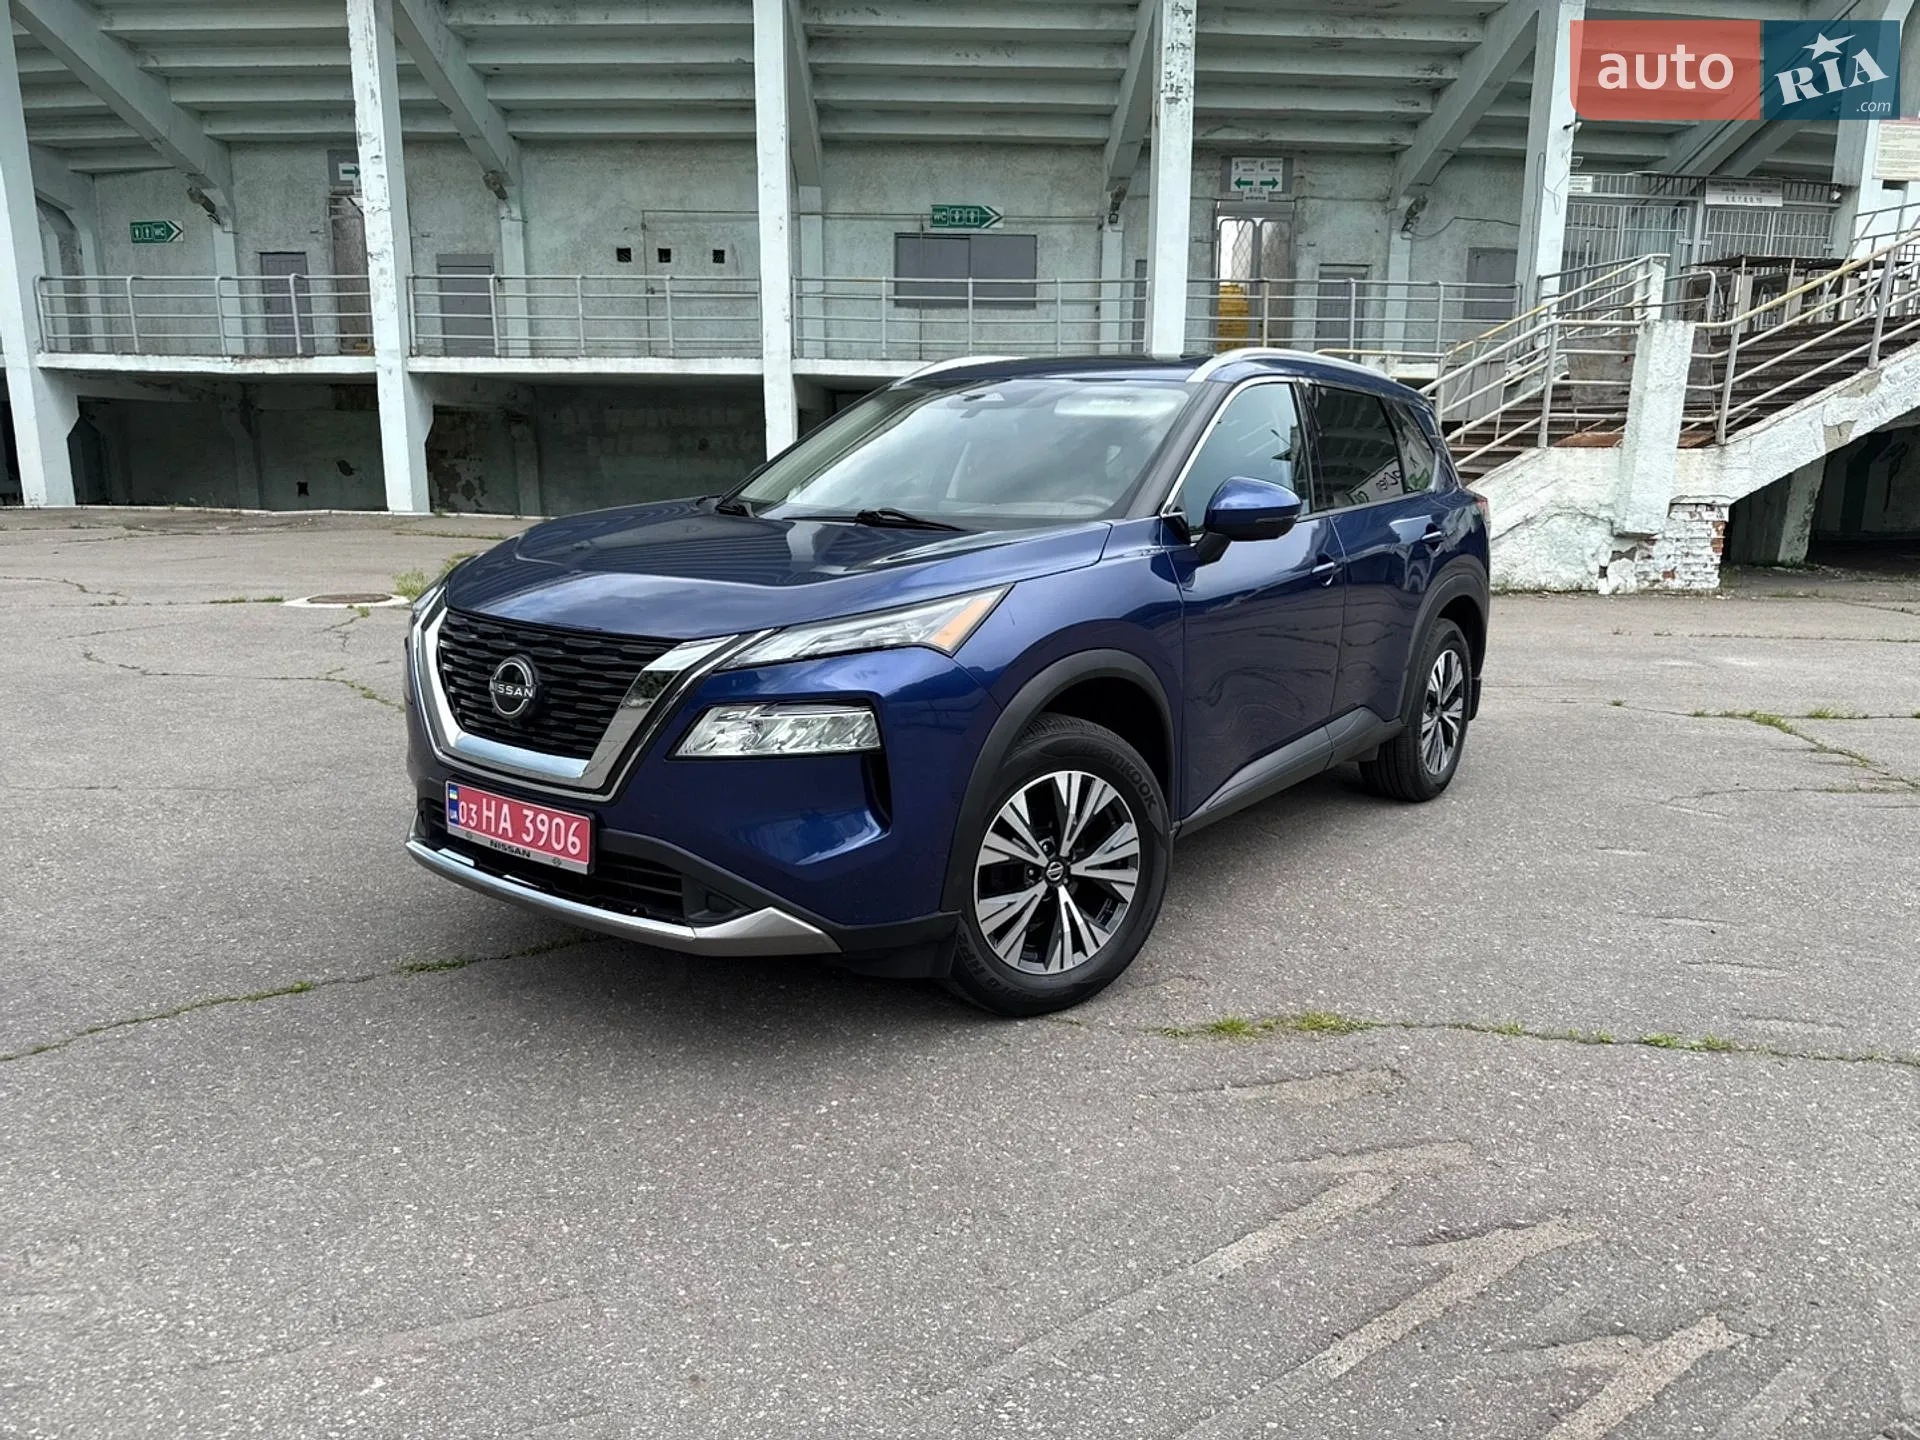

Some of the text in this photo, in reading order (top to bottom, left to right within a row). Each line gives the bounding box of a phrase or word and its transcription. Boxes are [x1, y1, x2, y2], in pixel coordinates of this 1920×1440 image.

[933, 211, 947, 221] WC
[458, 798, 582, 855] 03 HA 3906
[489, 840, 531, 858] NISSAN
